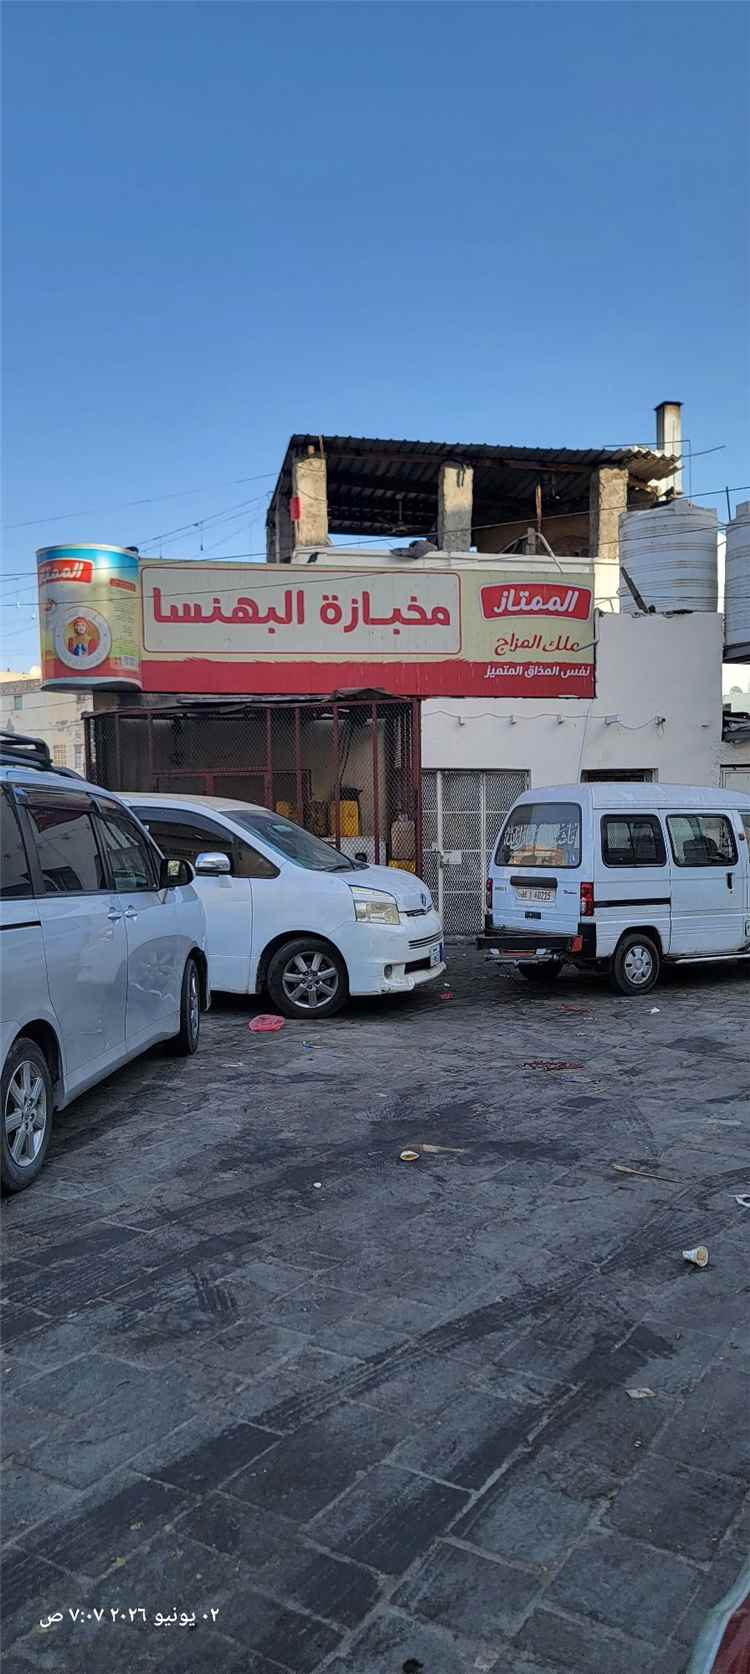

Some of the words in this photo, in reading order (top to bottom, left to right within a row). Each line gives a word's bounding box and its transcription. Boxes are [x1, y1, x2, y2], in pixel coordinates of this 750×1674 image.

[153, 587, 304, 633] البهنسا
[319, 591, 451, 634] مخبازة
[494, 588, 579, 613] الممتاز
[495, 632, 542, 656] المزاج
[484, 665, 523, 678] المتميز
[525, 665, 559, 678] المذاق
[561, 666, 590, 678] نفس
